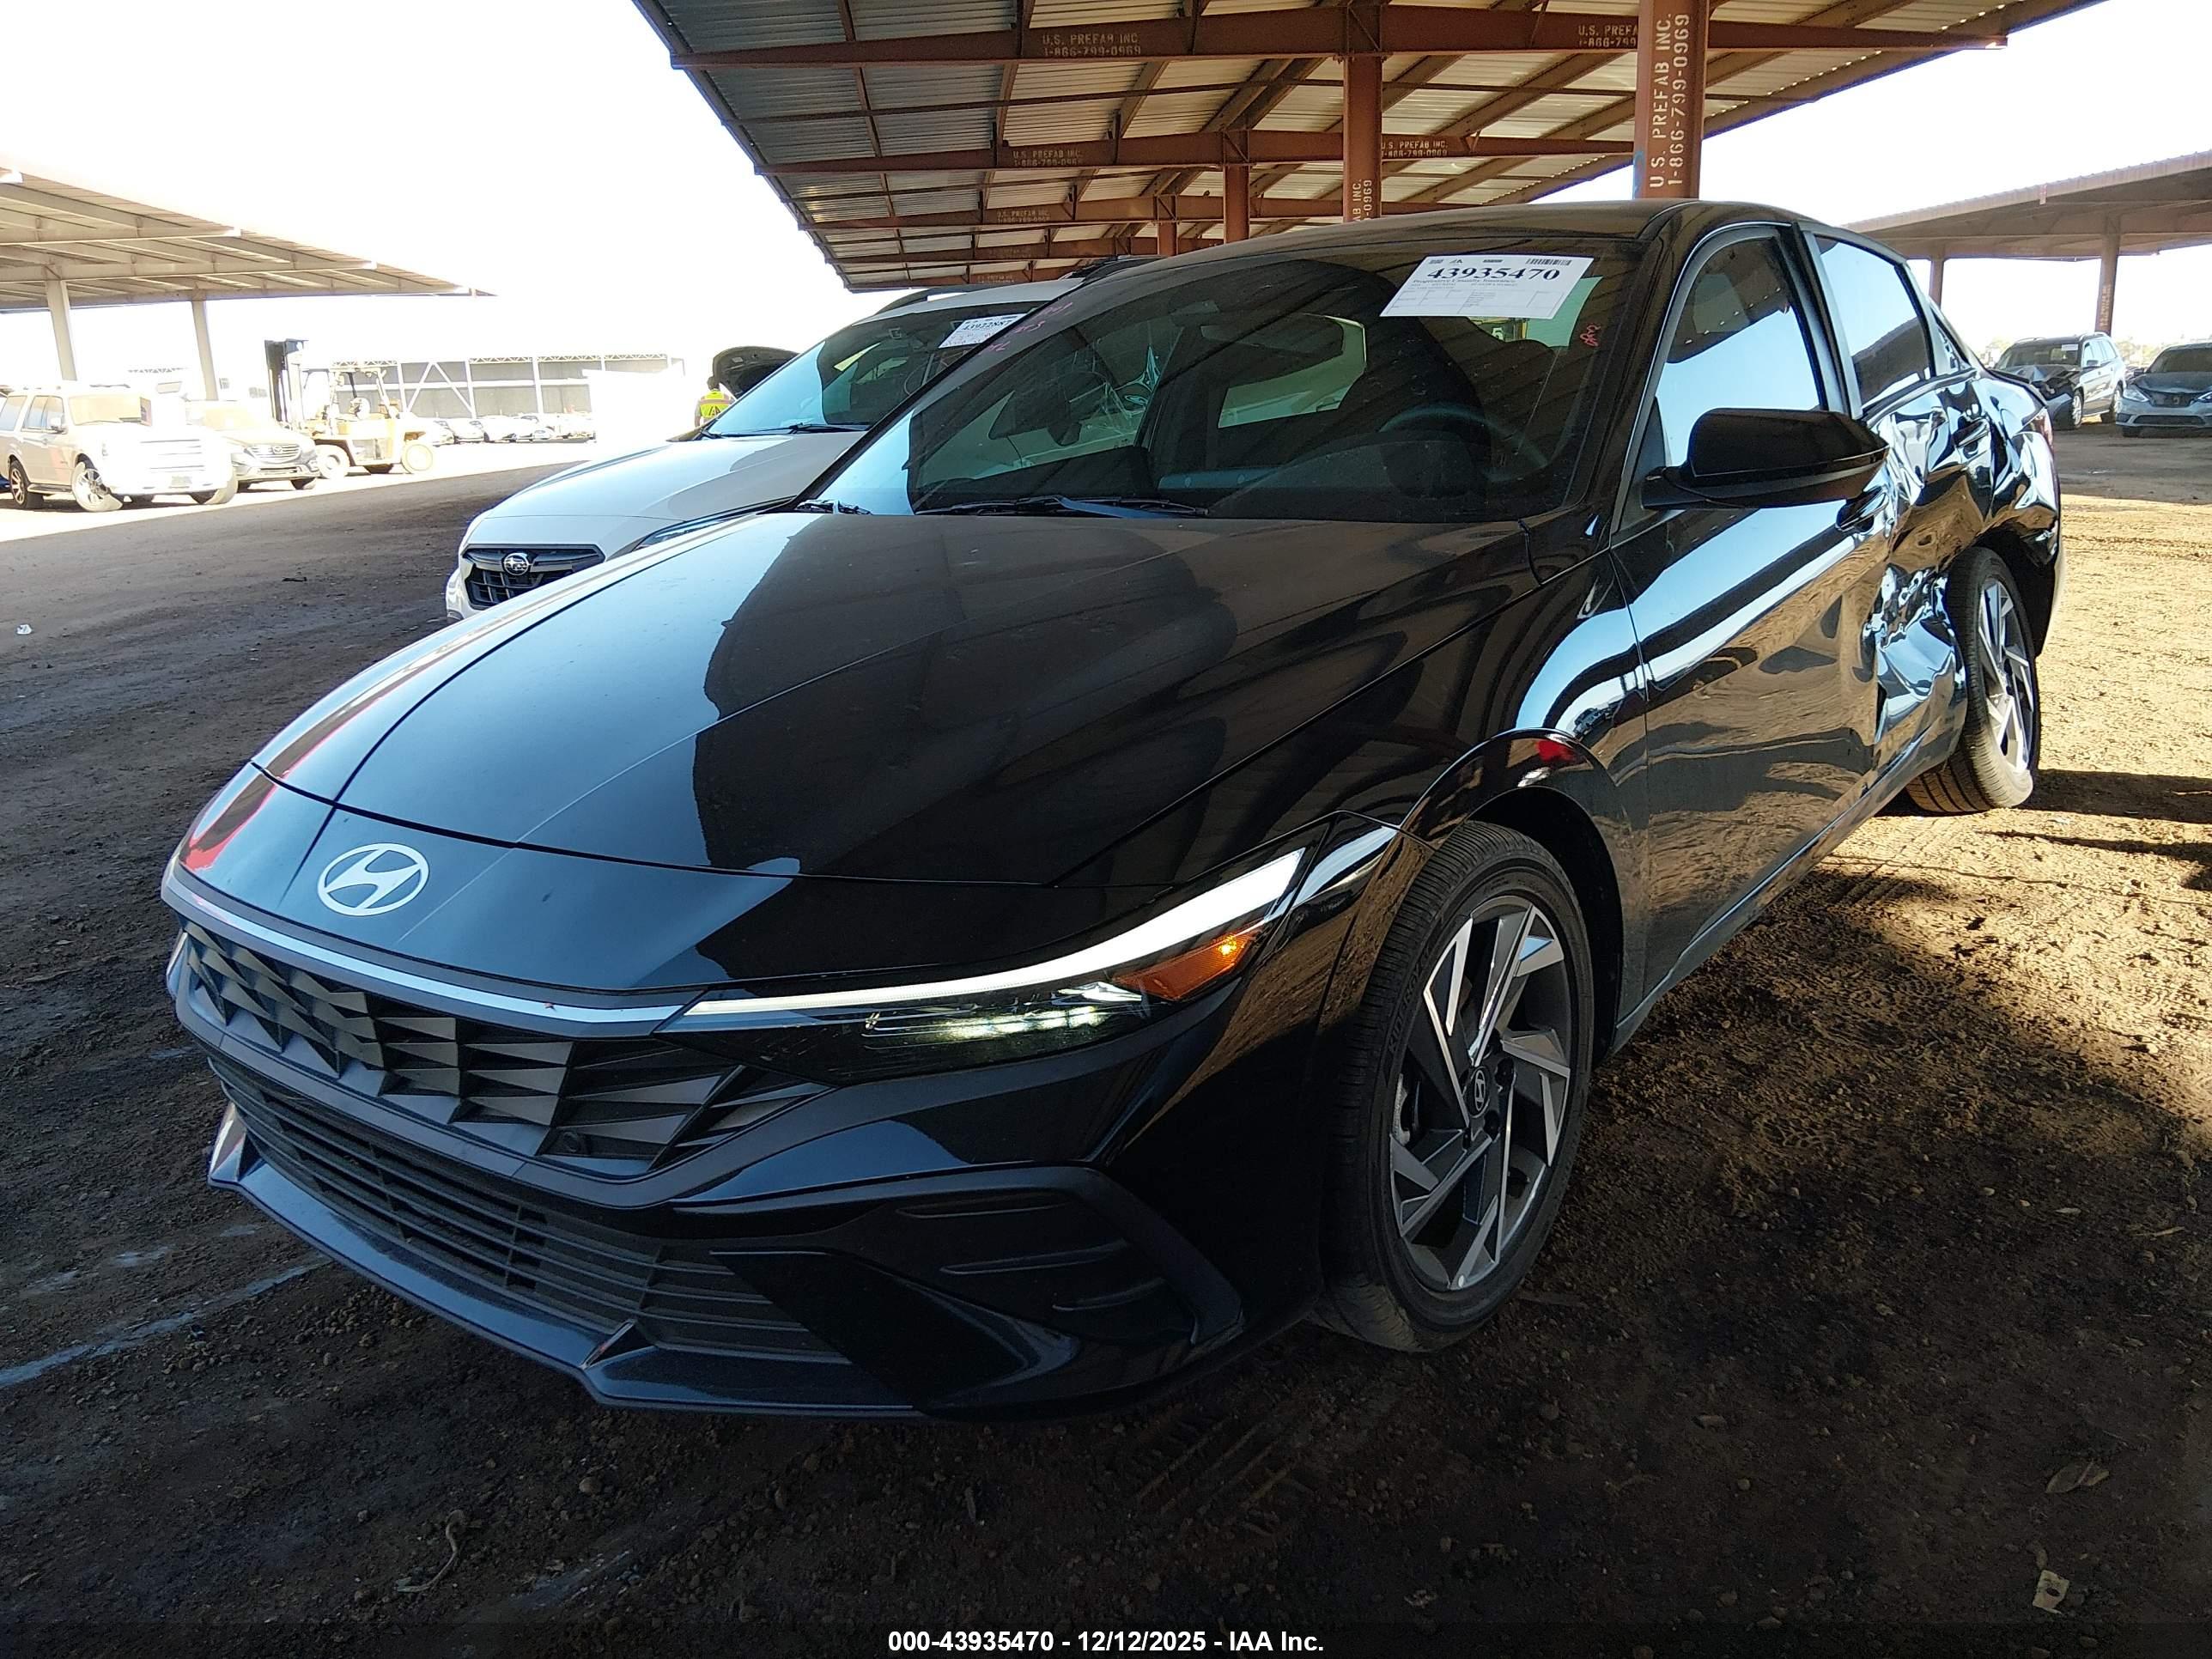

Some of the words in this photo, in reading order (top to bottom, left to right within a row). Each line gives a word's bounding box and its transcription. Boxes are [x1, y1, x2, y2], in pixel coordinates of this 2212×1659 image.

[1578, 24, 1599, 36] U.S.
[1656, 13, 1672, 51] INC.
[1652, 61, 1670, 139] PREFAB
[1668, 14, 1690, 186] 1-866-799-0969
[1650, 150, 1666, 188] U.S.
[1352, 179, 1362, 202] INC.
[1427, 267, 1561, 281] 43935470
